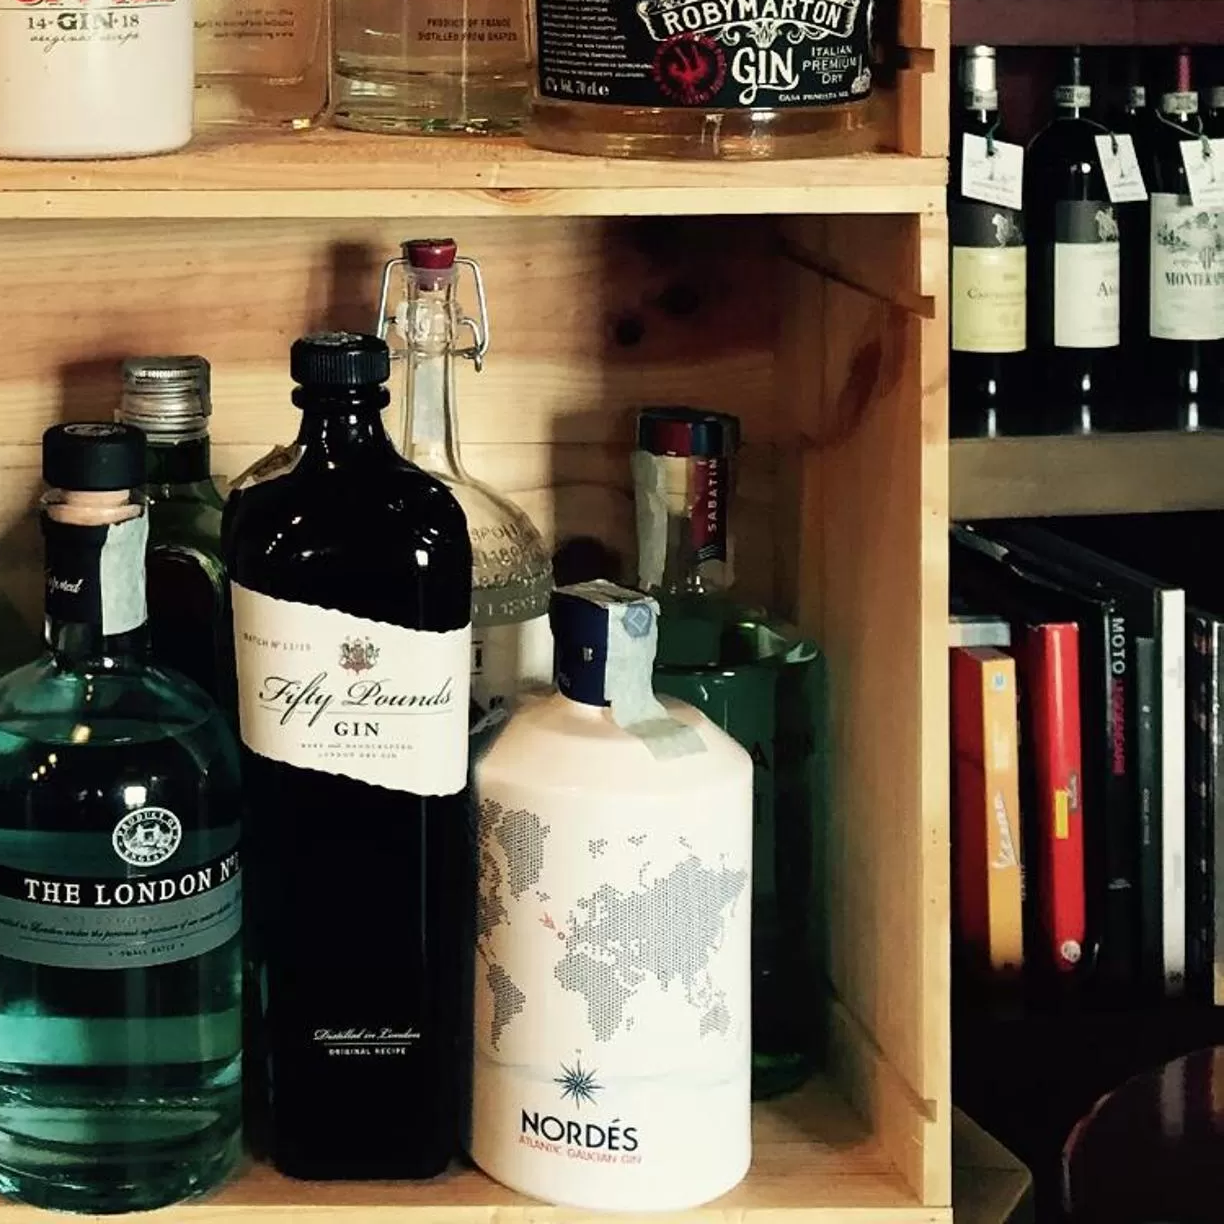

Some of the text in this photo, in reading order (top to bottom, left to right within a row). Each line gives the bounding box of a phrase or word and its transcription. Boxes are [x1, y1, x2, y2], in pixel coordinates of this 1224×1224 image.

[27, 12, 140, 31] 14 GIN 18
[802, 54, 857, 72] PREMIUM
[811, 45, 853, 56] ITALIAN
[731, 46, 799, 105] GIN
[821, 72, 843, 85] DRY
[1112, 617, 1126, 675] MOTO
[258, 671, 452, 728] Fifty Pounds
[333, 721, 380, 737] GIN
[24, 877, 81, 905] THE
[94, 869, 212, 906] LONDON
[521, 1107, 639, 1152] NORDÉS
[517, 1134, 562, 1156] ATLANTIC
[620, 1153, 642, 1165] GIN
